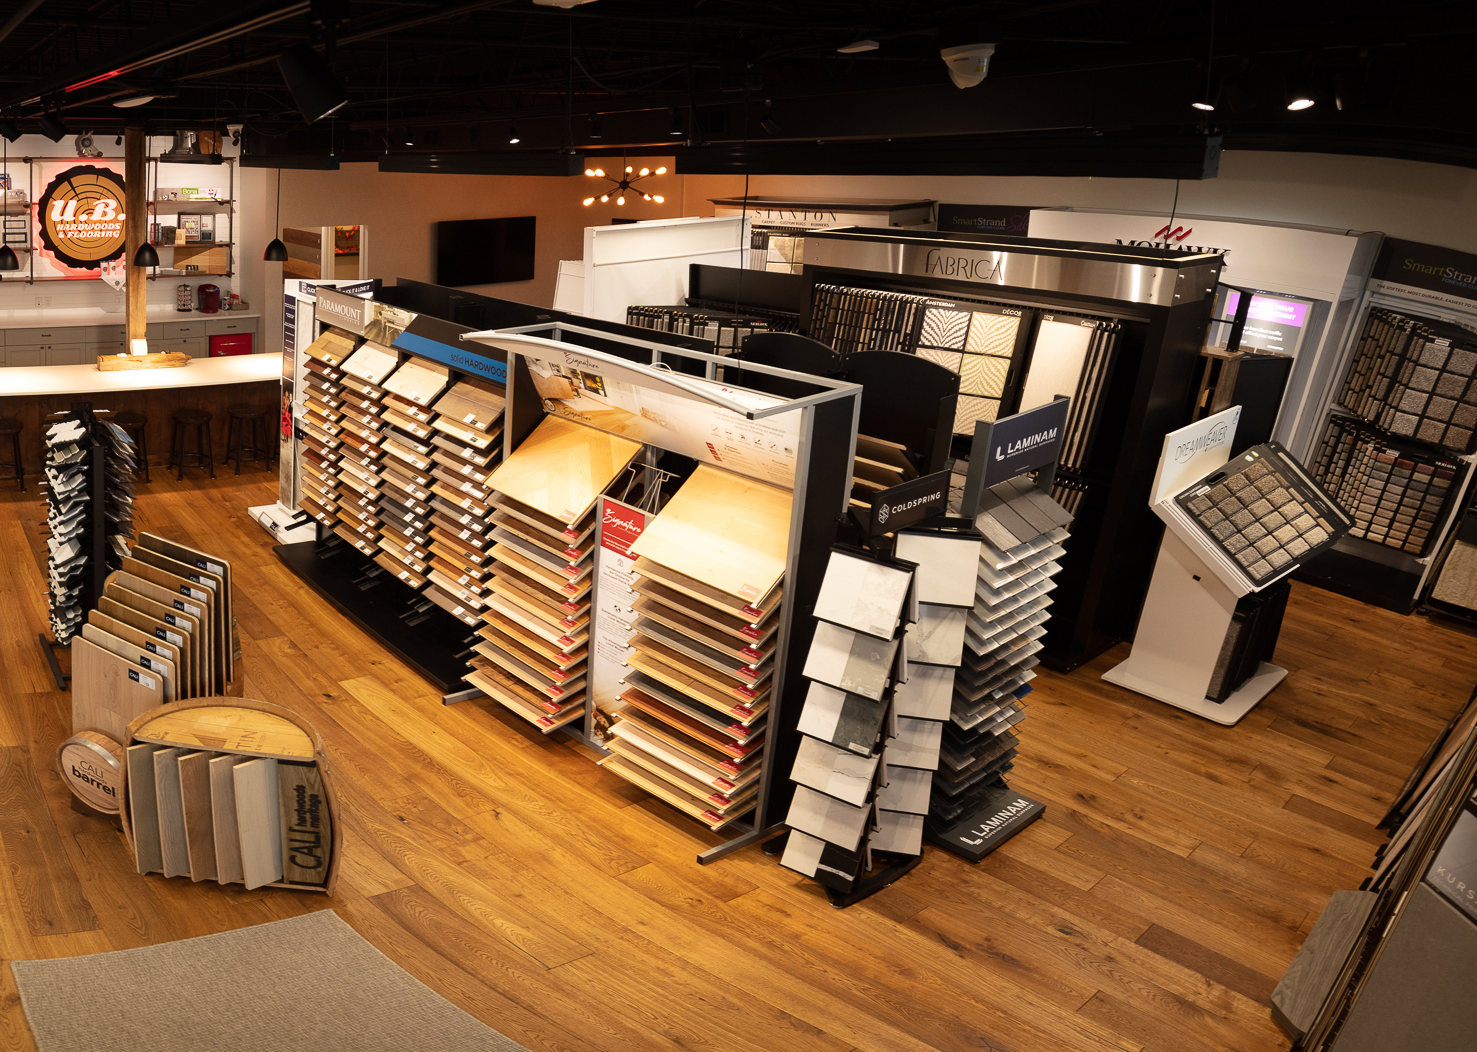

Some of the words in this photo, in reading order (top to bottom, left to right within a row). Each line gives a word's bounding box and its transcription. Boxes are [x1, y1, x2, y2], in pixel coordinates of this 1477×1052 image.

[51, 199, 126, 221] U.B.
[755, 208, 836, 222] STANTON
[953, 216, 1006, 227] SmartStrand
[56, 223, 122, 231] HARDWOODS
[924, 249, 1003, 281] FABRICA
[1403, 258, 1477, 284] SmartStra
[1386, 285, 1406, 294] SOFTEST,
[1445, 298, 1464, 306] EASIEST
[1442, 278, 1467, 288] FOREVER
[319, 296, 361, 320] PARAMOUNT
[451, 354, 464, 365] solid
[465, 357, 507, 379] HARDWOOD
[1007, 427, 1057, 454] LAMINAM
[1175, 425, 1228, 461] DREAMWEAVER
[892, 491, 941, 514] COLDSPRING
[141, 658, 150, 666] CALI
[72, 765, 116, 797] barrel
[80, 760, 104, 779] CALI
[293, 785, 307, 827] hardwoods
[307, 793, 322, 828] meritage
[971, 798, 1030, 837] LAMINAM
[289, 826, 323, 869] CALI
[1437, 866, 1477, 903] KURS
